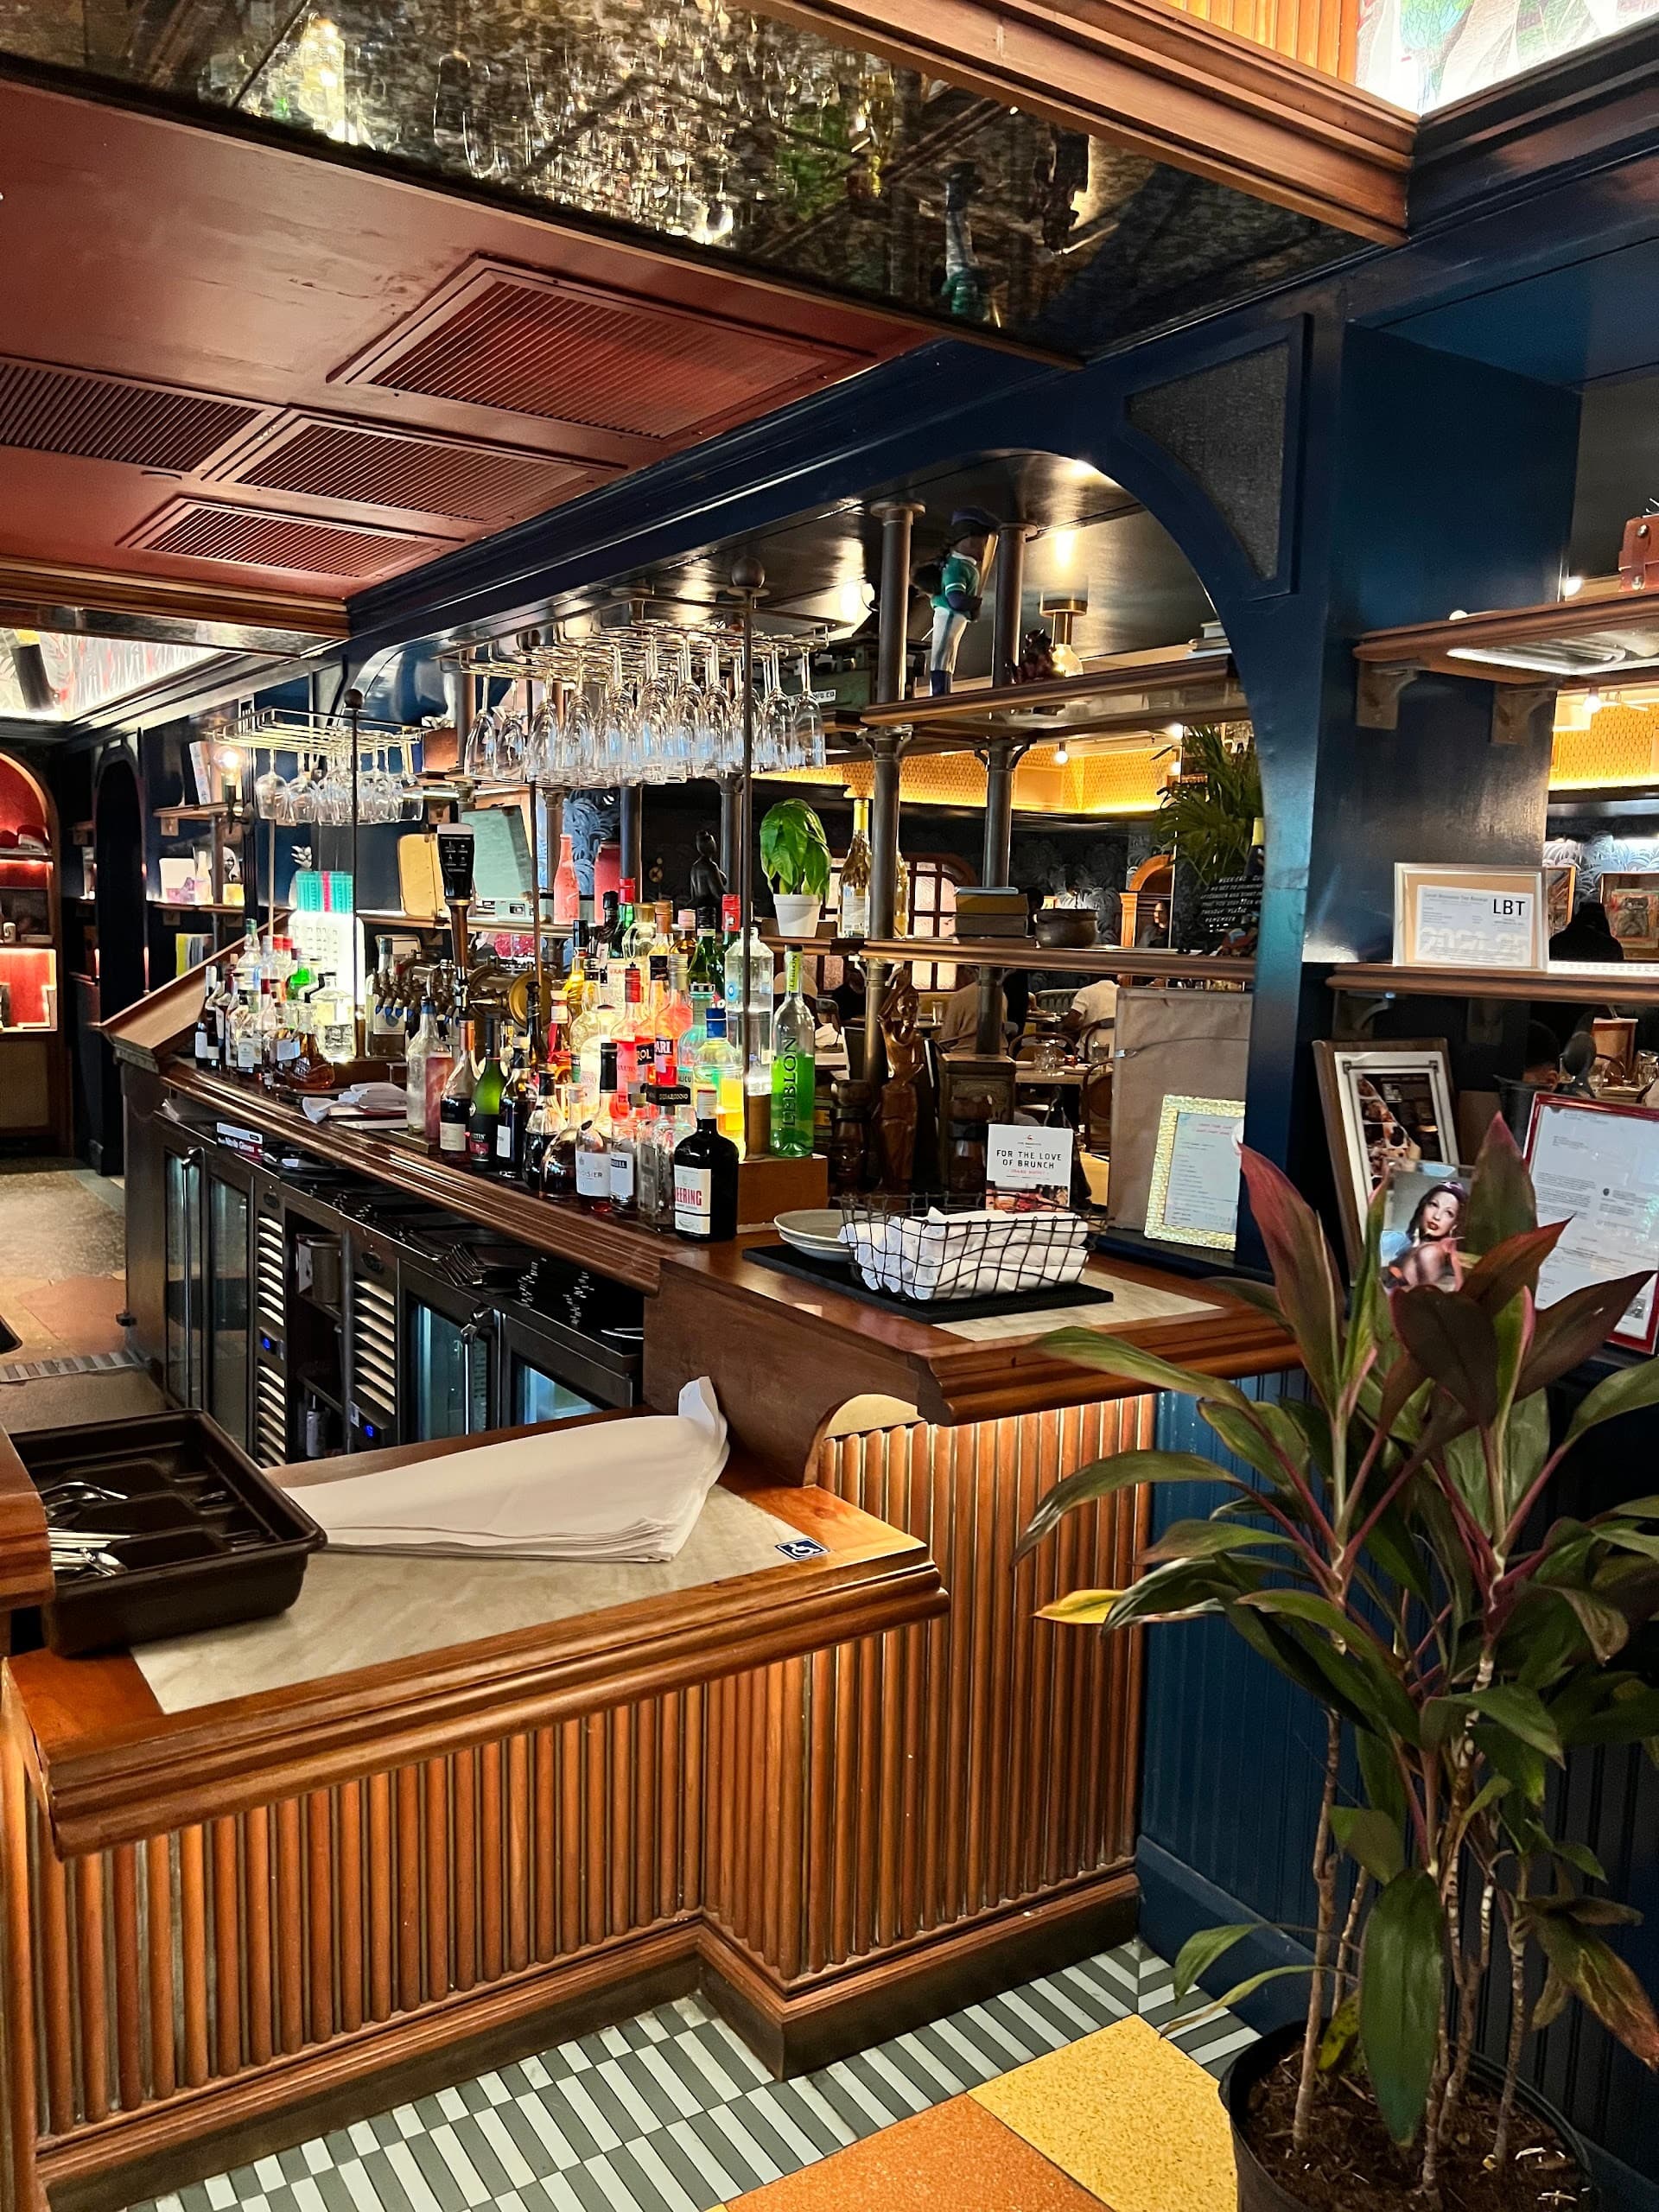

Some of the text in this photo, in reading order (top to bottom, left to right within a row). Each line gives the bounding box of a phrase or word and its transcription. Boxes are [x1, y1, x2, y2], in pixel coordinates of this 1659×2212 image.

[1493, 899, 1525, 916] LBT
[782, 1037, 798, 1127] LEBLON
[1018, 1151, 1035, 1160] THE
[1039, 1153, 1062, 1161] LOVE
[1017, 1160, 1054, 1169] BRUNCH
